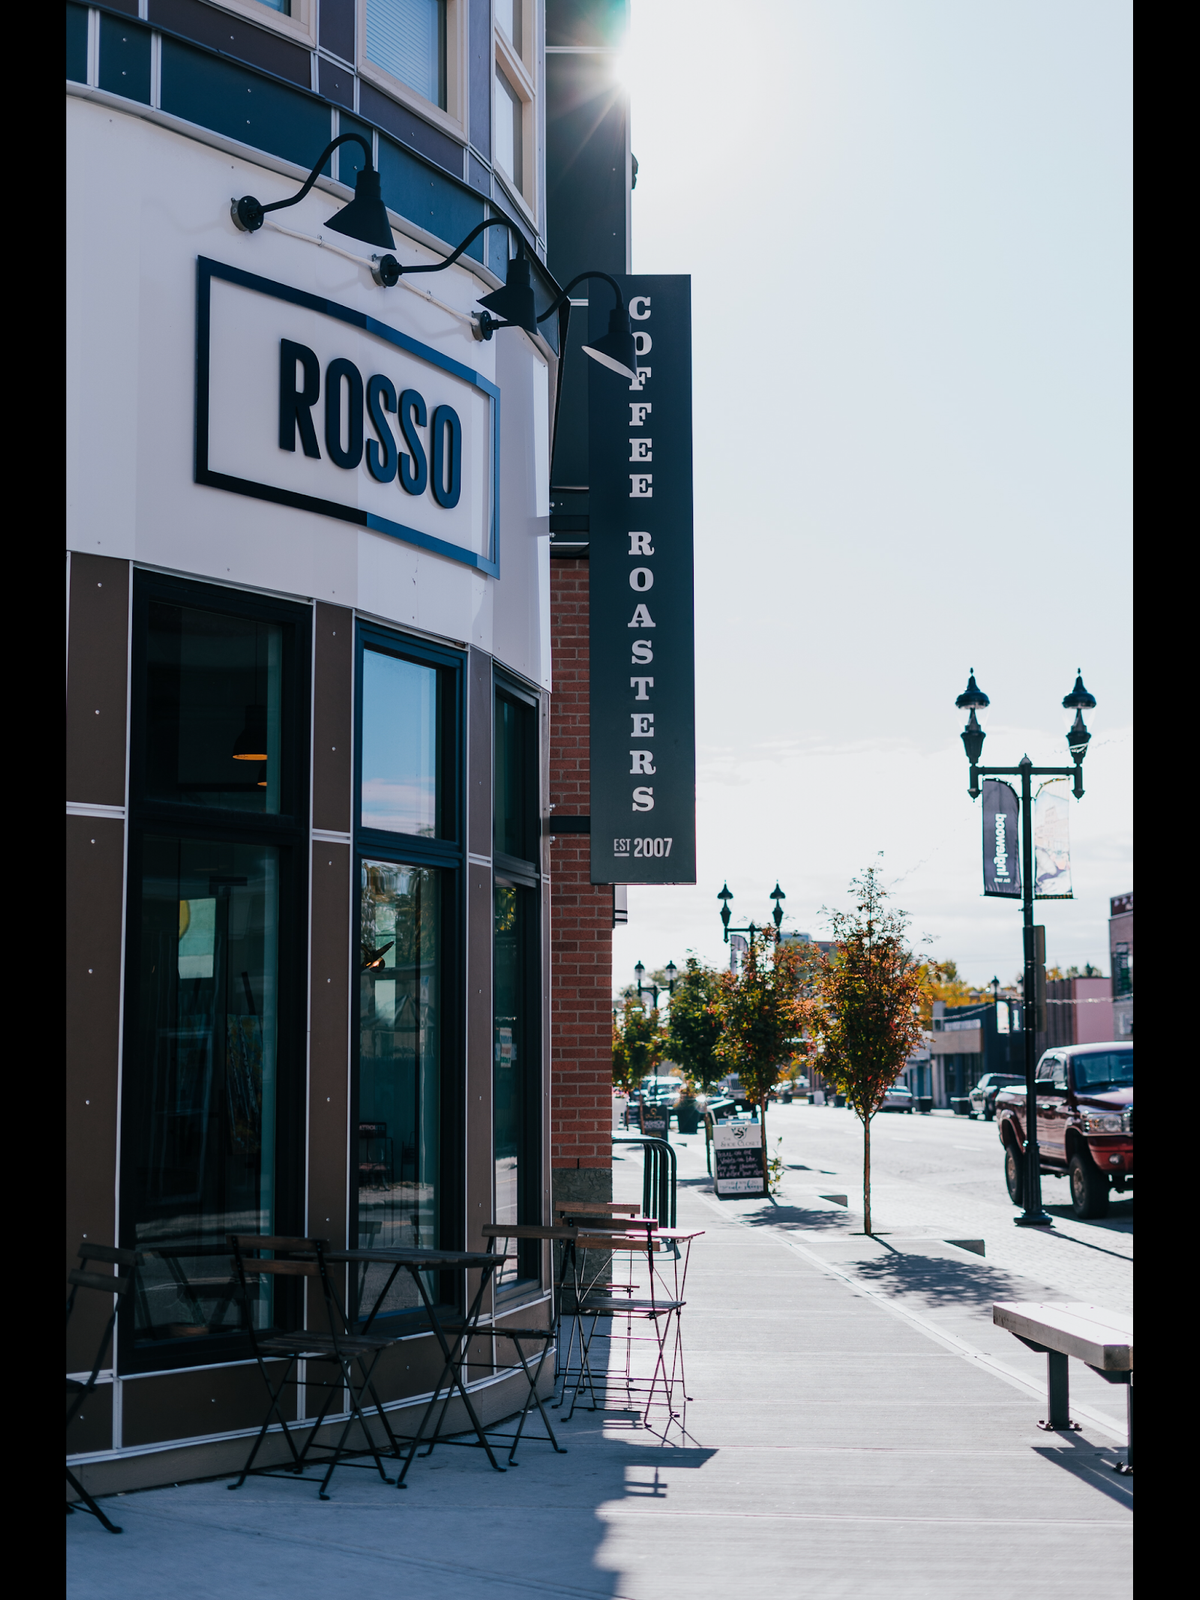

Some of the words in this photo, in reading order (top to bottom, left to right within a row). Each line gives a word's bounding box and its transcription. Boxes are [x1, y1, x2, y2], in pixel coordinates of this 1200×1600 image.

[279, 338, 462, 509] ROSSO
[628, 296, 653, 498] COFFEE
[627, 531, 657, 812] ROASTERS
[614, 838, 631, 851] EST
[633, 837, 673, 857] 2007
